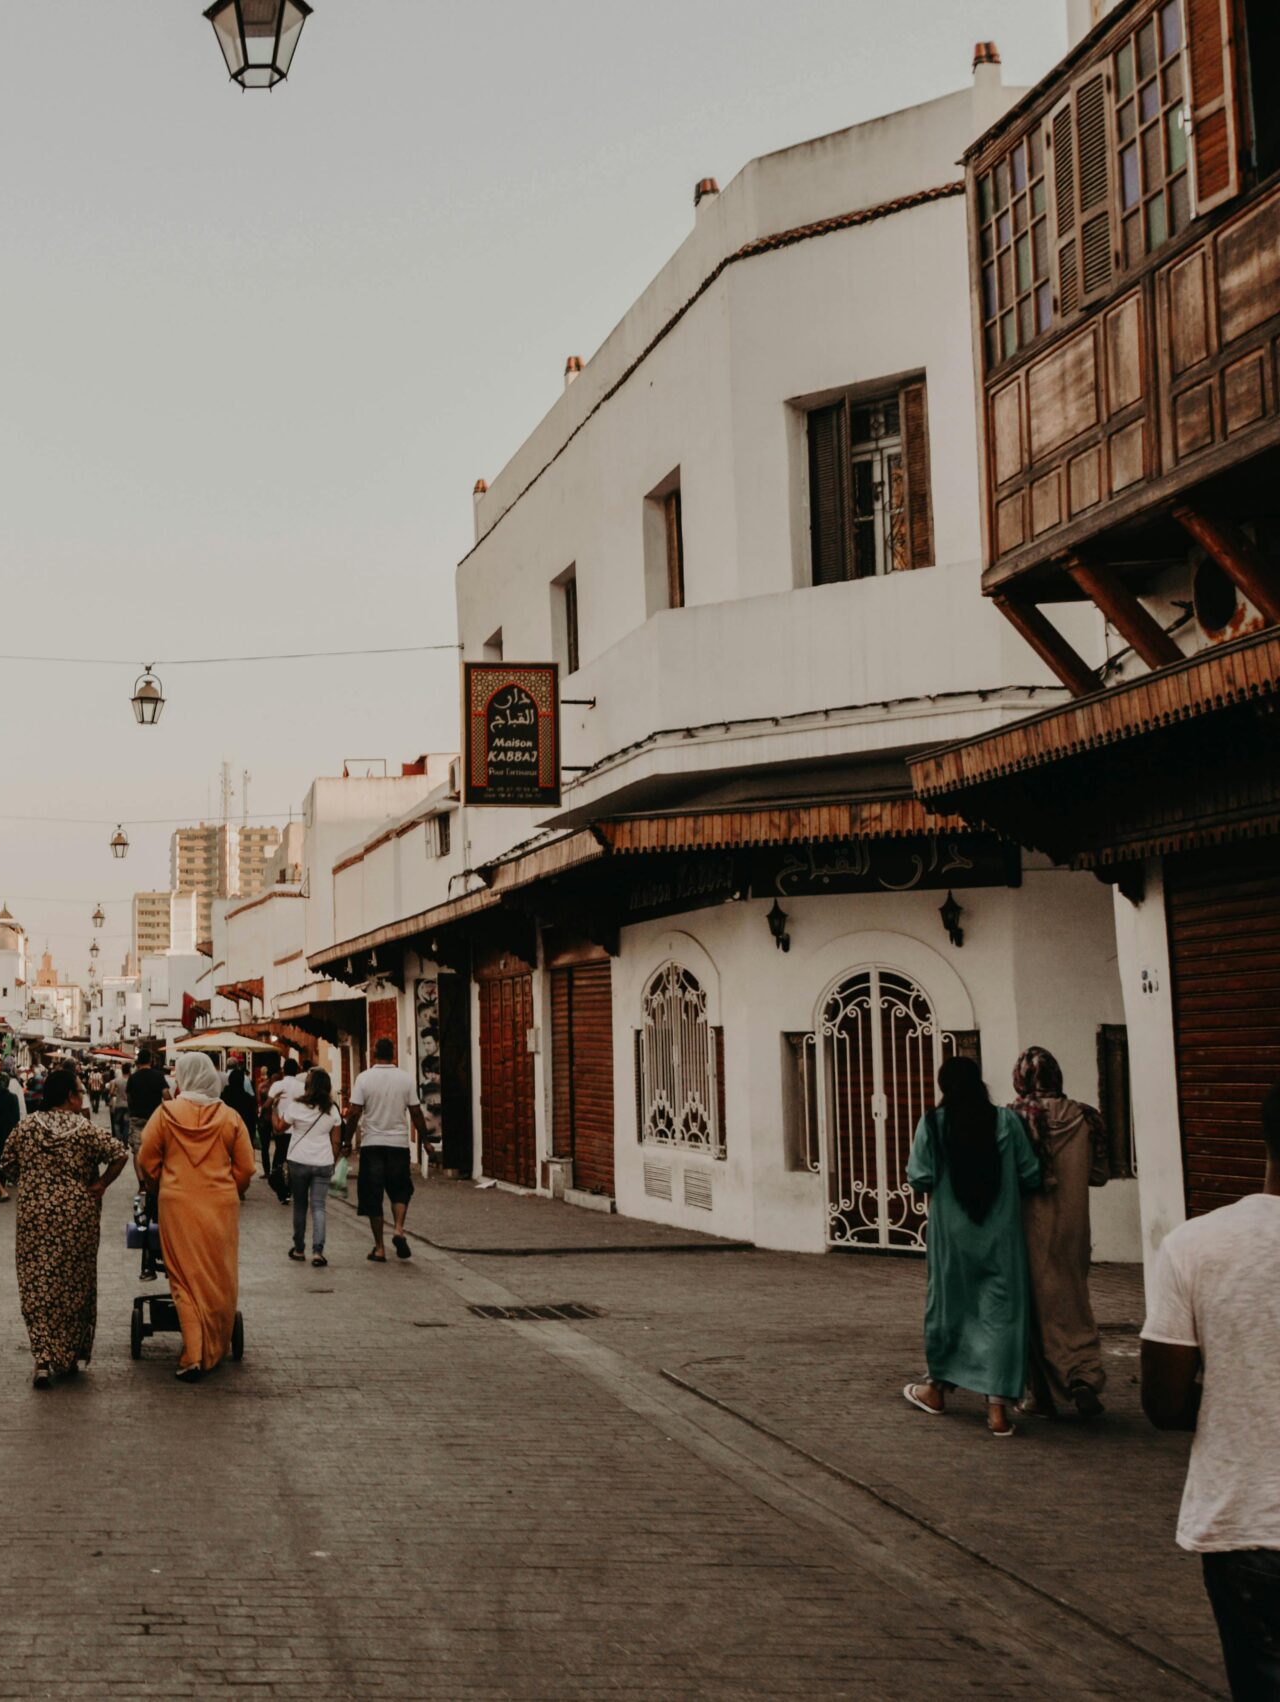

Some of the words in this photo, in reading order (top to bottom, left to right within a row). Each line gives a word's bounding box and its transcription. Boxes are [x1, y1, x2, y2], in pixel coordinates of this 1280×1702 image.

[493, 688, 531, 709] دار
[490, 708, 535, 732] القباج
[492, 737, 532, 747] Maison
[487, 751, 537, 763] KABBAJ
[878, 834, 973, 890] دار
